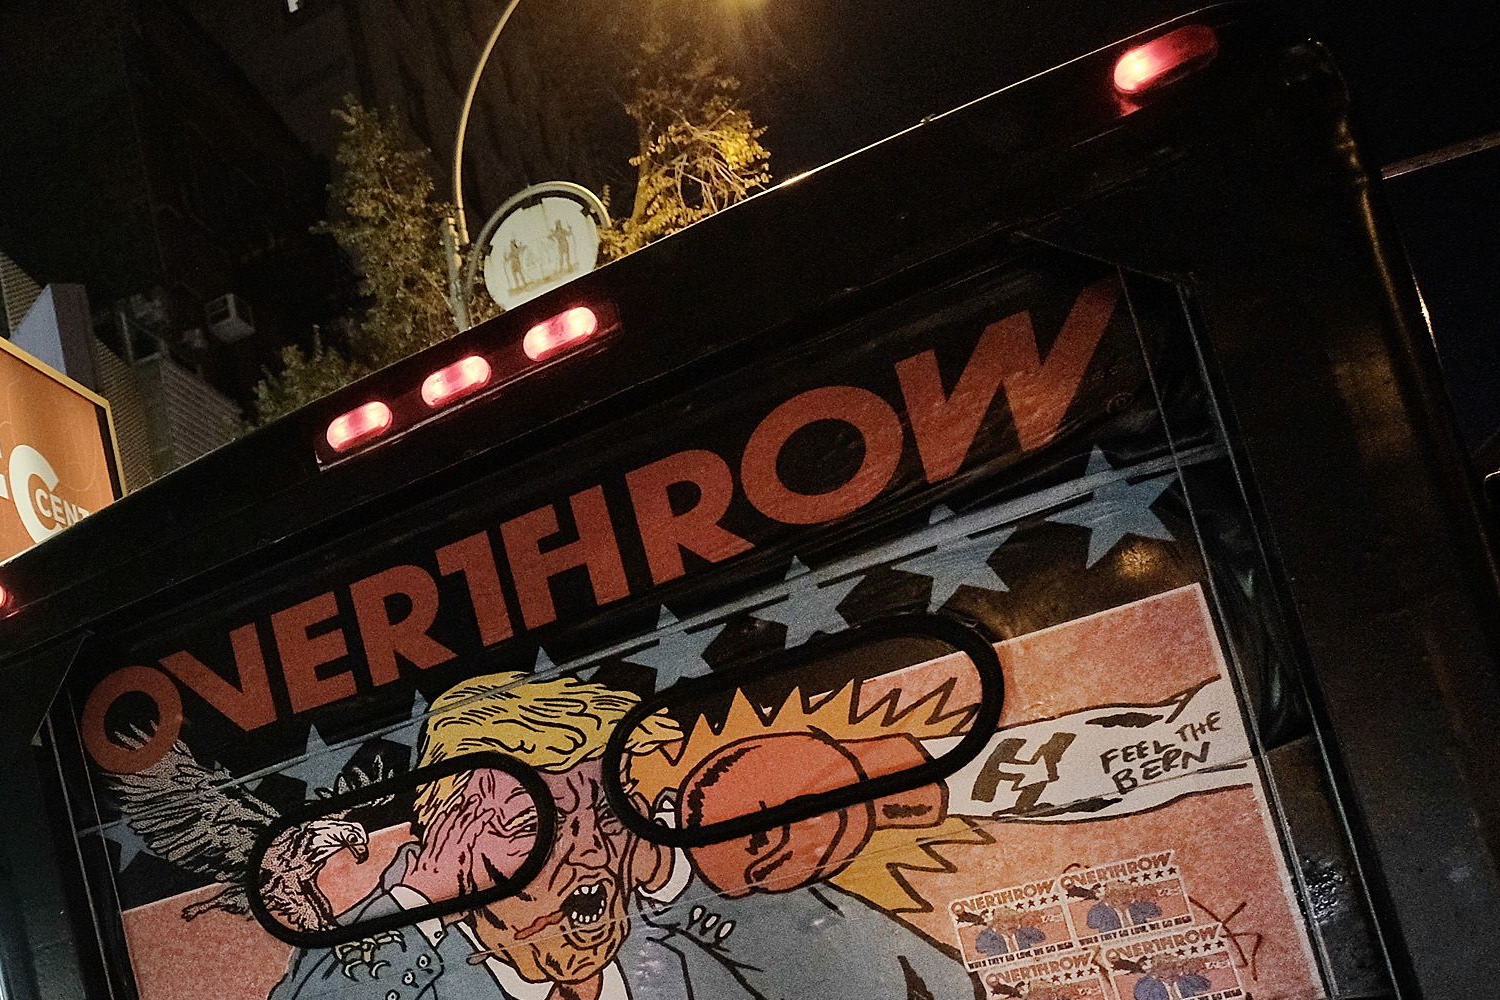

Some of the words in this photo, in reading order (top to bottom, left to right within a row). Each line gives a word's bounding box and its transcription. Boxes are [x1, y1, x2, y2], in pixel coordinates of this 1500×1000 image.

[81, 285, 1119, 774] OVERTHROW
[1099, 740, 1176, 775] FEEL
[1175, 711, 1222, 744] THE
[1112, 741, 1210, 795] BERN
[1060, 852, 1172, 889] OVERTHROW
[951, 879, 1056, 915] OVERTHROW
[1105, 924, 1220, 963] OVERTHROW
[985, 952, 1092, 988] OVERTHROW
